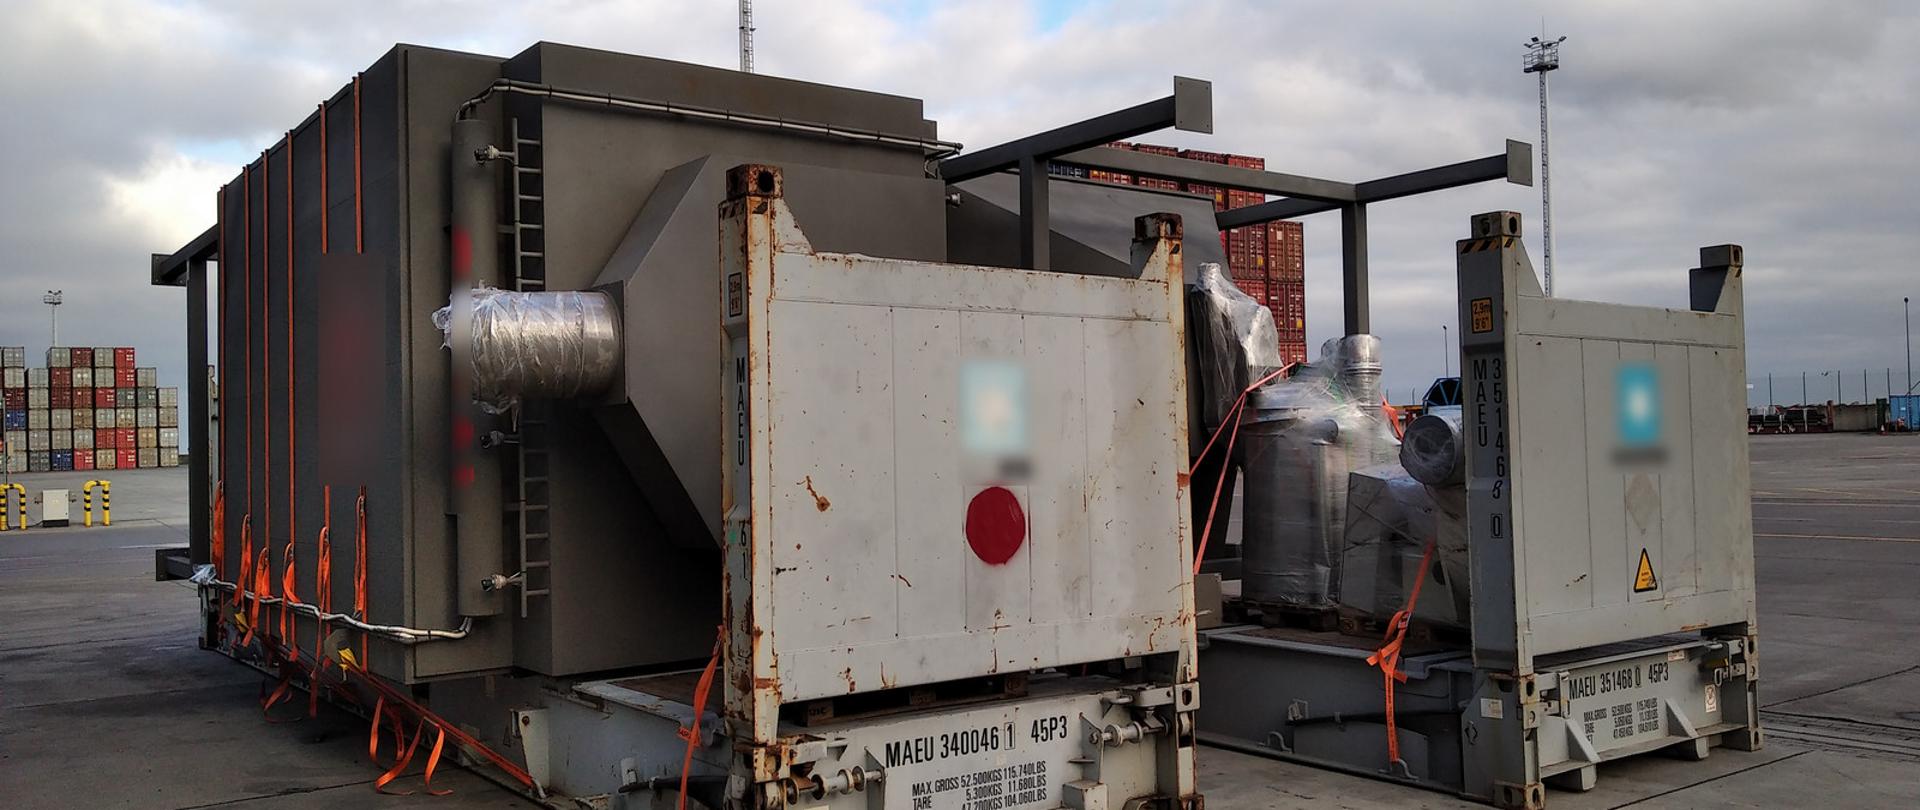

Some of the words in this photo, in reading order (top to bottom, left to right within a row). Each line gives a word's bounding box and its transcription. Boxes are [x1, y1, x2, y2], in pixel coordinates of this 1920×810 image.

[737, 357, 745, 465] MAEU
[1473, 359, 1488, 447] MAEU
[1569, 676, 1596, 700] MAEU
[1600, 668, 1633, 694] 351468
[1648, 662, 1669, 684] 45P3
[885, 736, 934, 768] MAEU
[940, 726, 999, 759] 340046
[1005, 723, 1015, 749] 1
[1031, 715, 1068, 743] 45P3
[912, 796, 932, 810] TARE
[966, 783, 1003, 801] 5.300KGS
[1008, 774, 1047, 792] 11.680LBS
[934, 777, 960, 793] GROSS
[960, 768, 1003, 788] 52.500KGS
[1003, 761, 1046, 779] 115.740LBS
[1004, 788, 1047, 808] 104.060LBS
